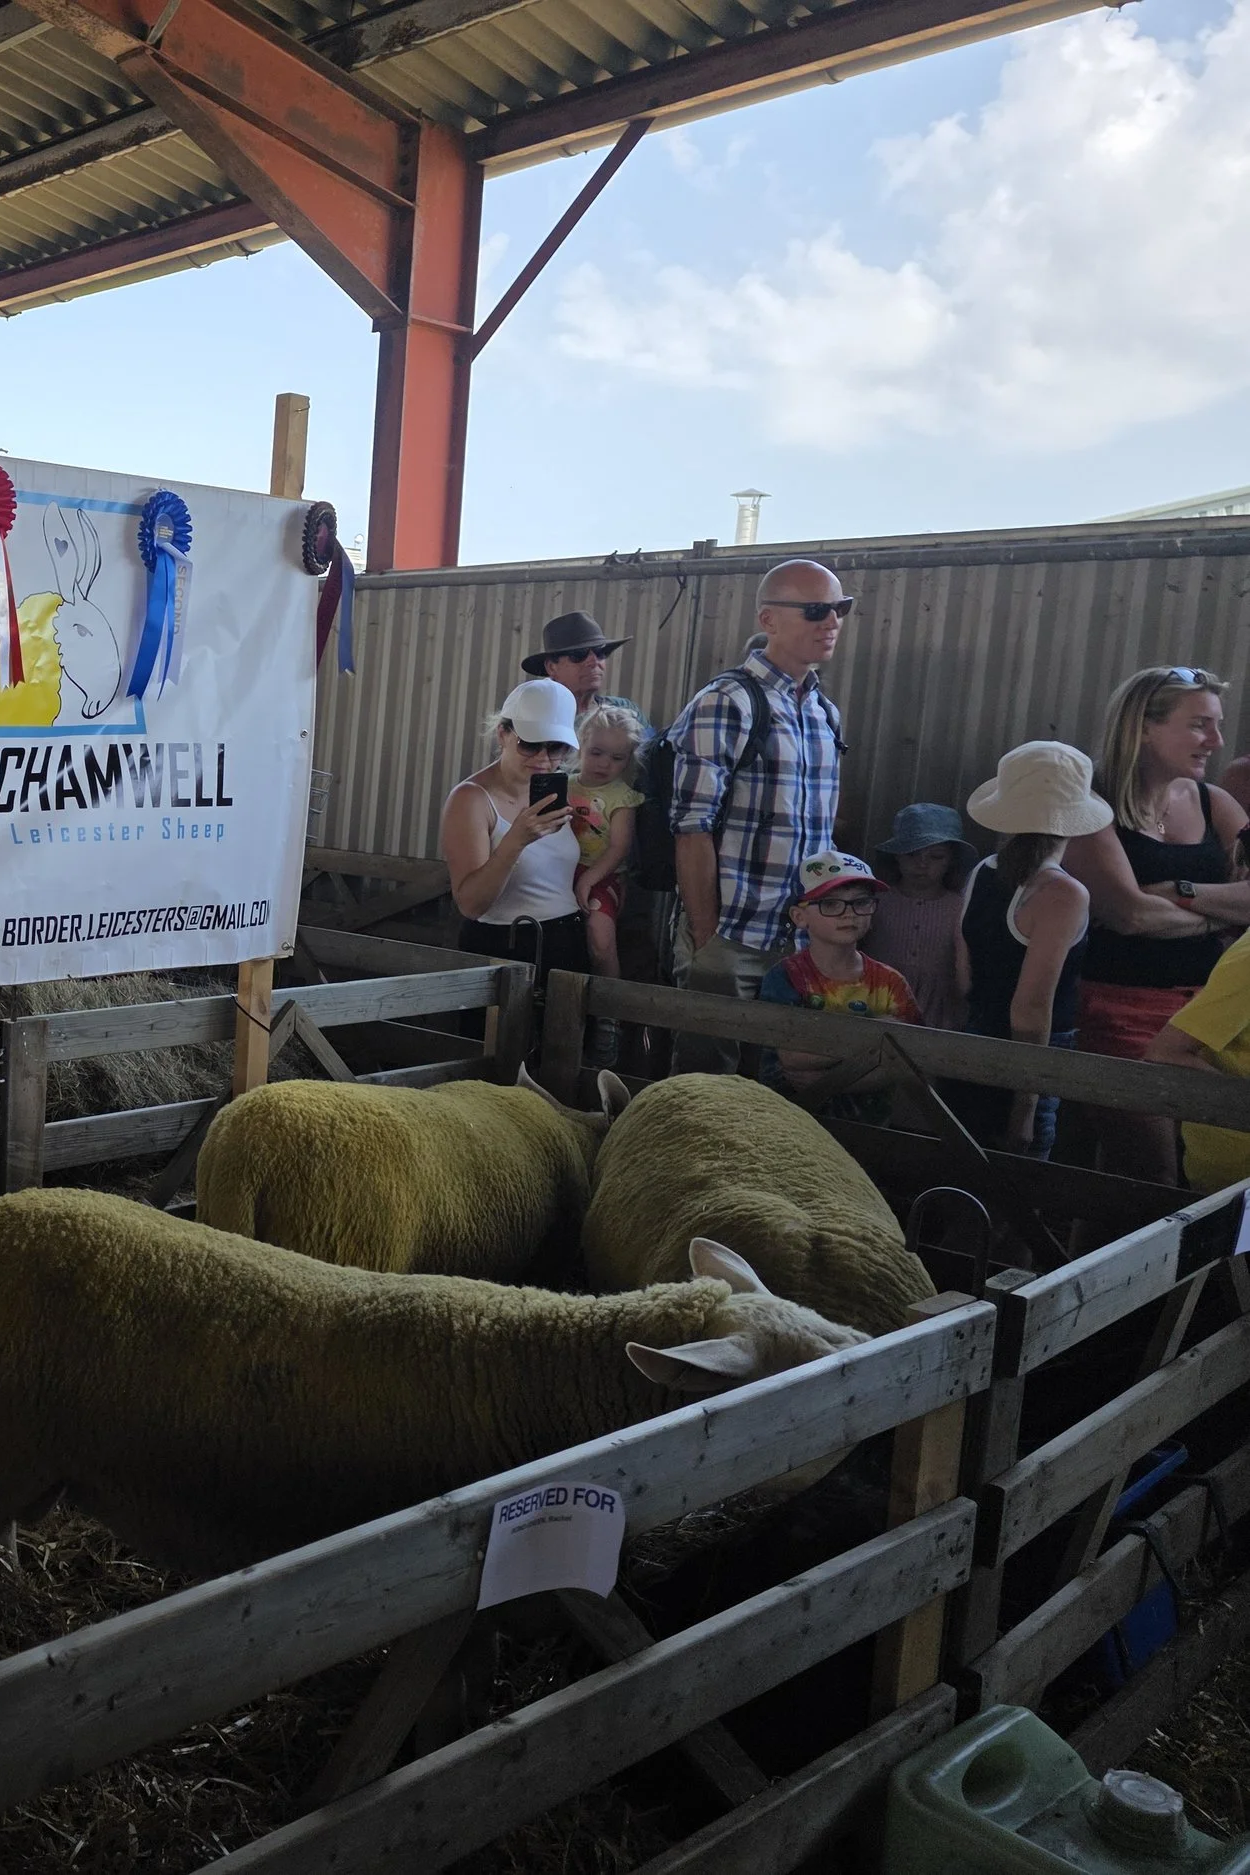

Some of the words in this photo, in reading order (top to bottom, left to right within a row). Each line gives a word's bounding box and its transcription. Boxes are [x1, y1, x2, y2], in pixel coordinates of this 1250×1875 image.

[11, 820, 145, 845] Leicester
[161, 817, 225, 842] Sheep
[498, 1487, 568, 1525] RESERVED
[572, 1487, 617, 1514] FOR
